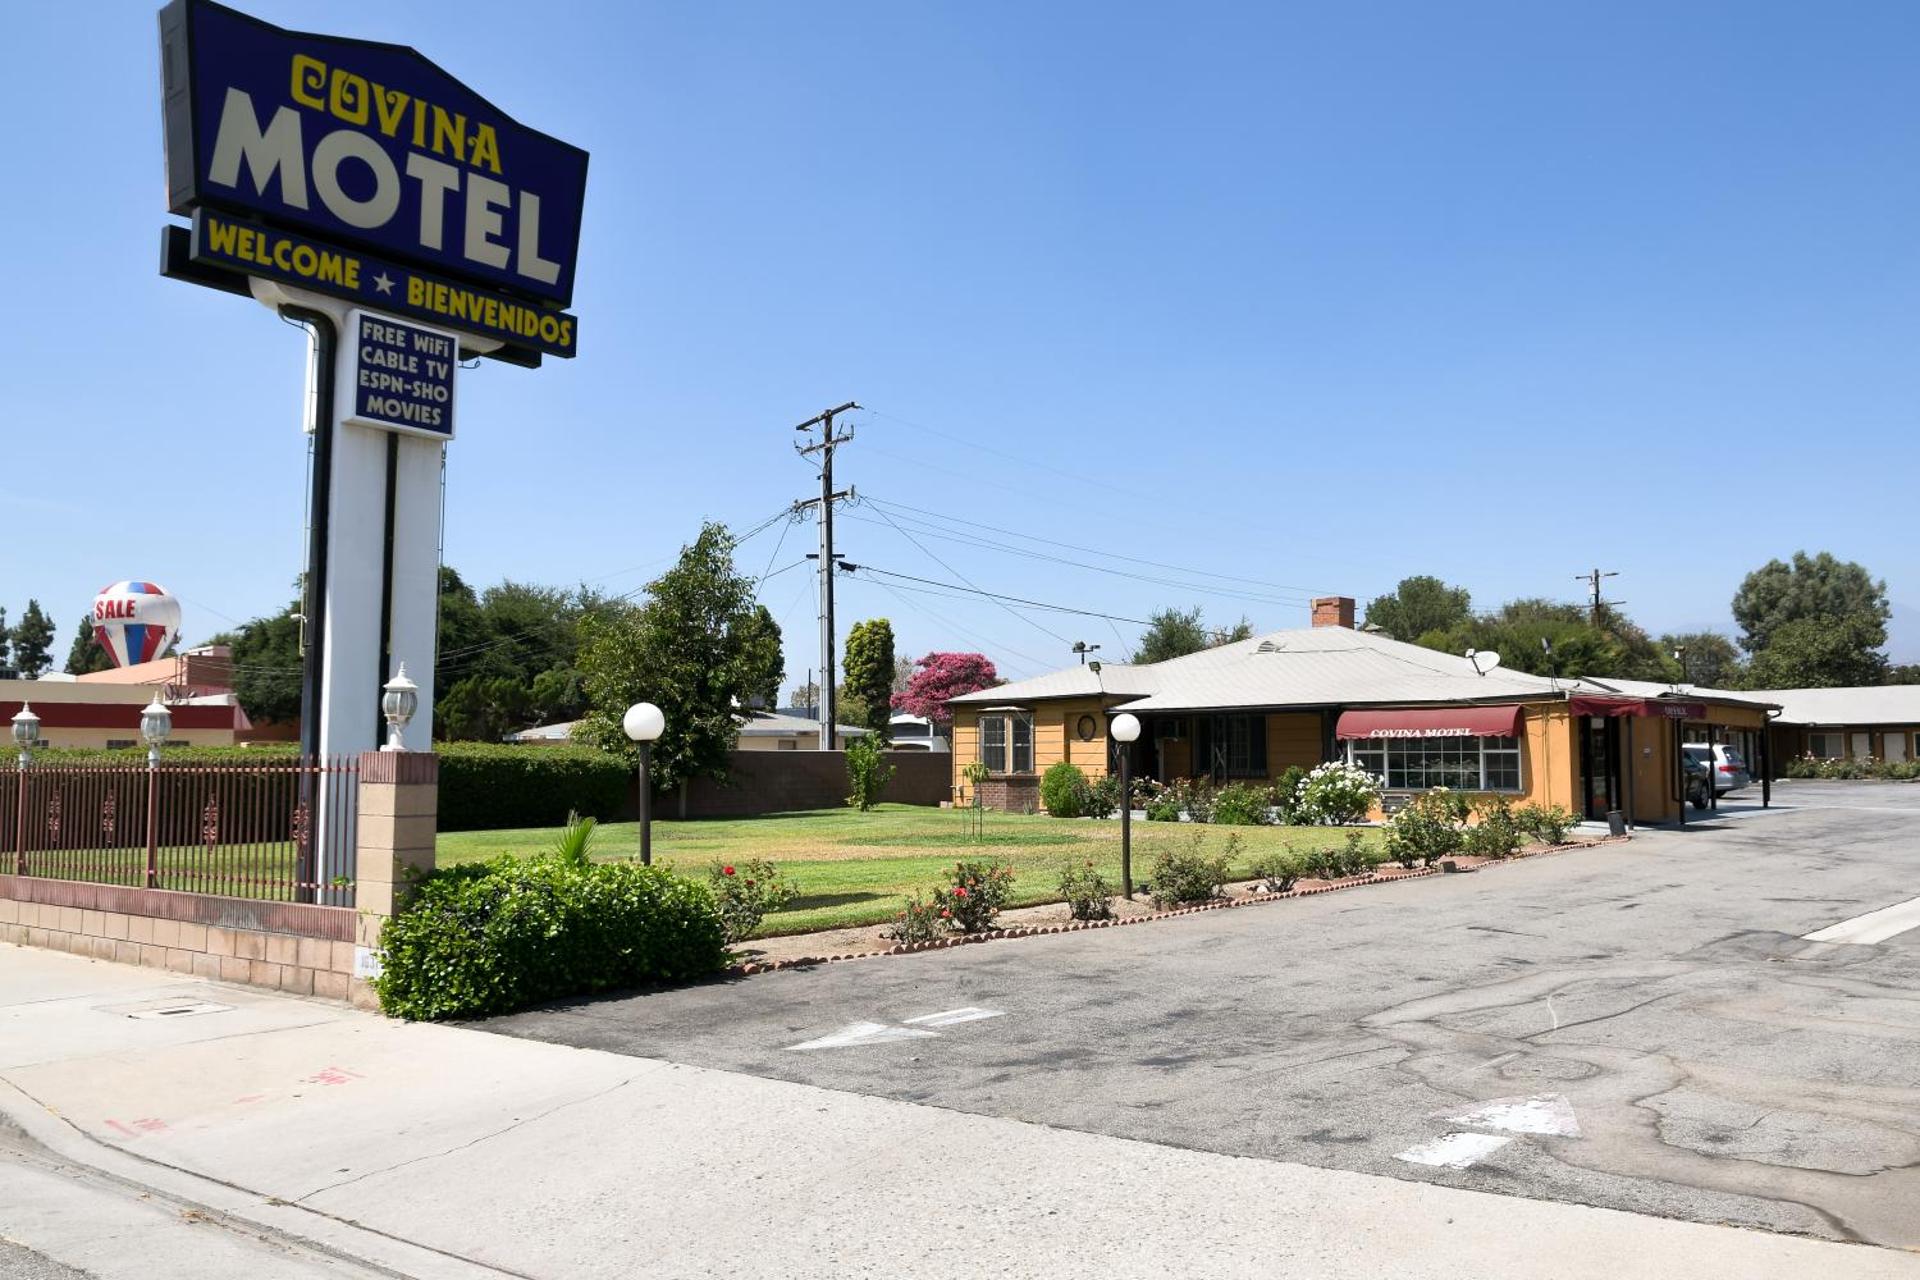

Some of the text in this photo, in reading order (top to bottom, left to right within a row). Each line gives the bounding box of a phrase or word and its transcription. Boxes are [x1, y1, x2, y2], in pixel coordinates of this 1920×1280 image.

[290, 53, 503, 175] COVINA
[208, 86, 561, 286] MOTEL
[208, 218, 572, 347] WELCOME BIENVENIDOS
[362, 321, 449, 358] FREE WiFi
[361, 346, 449, 380] CABLE TV
[359, 369, 449, 403] ESPN-SHO
[366, 394, 442, 426] MOVIES
[95, 599, 136, 620] SALE
[1369, 727, 1473, 738] COVINA MOTEL
